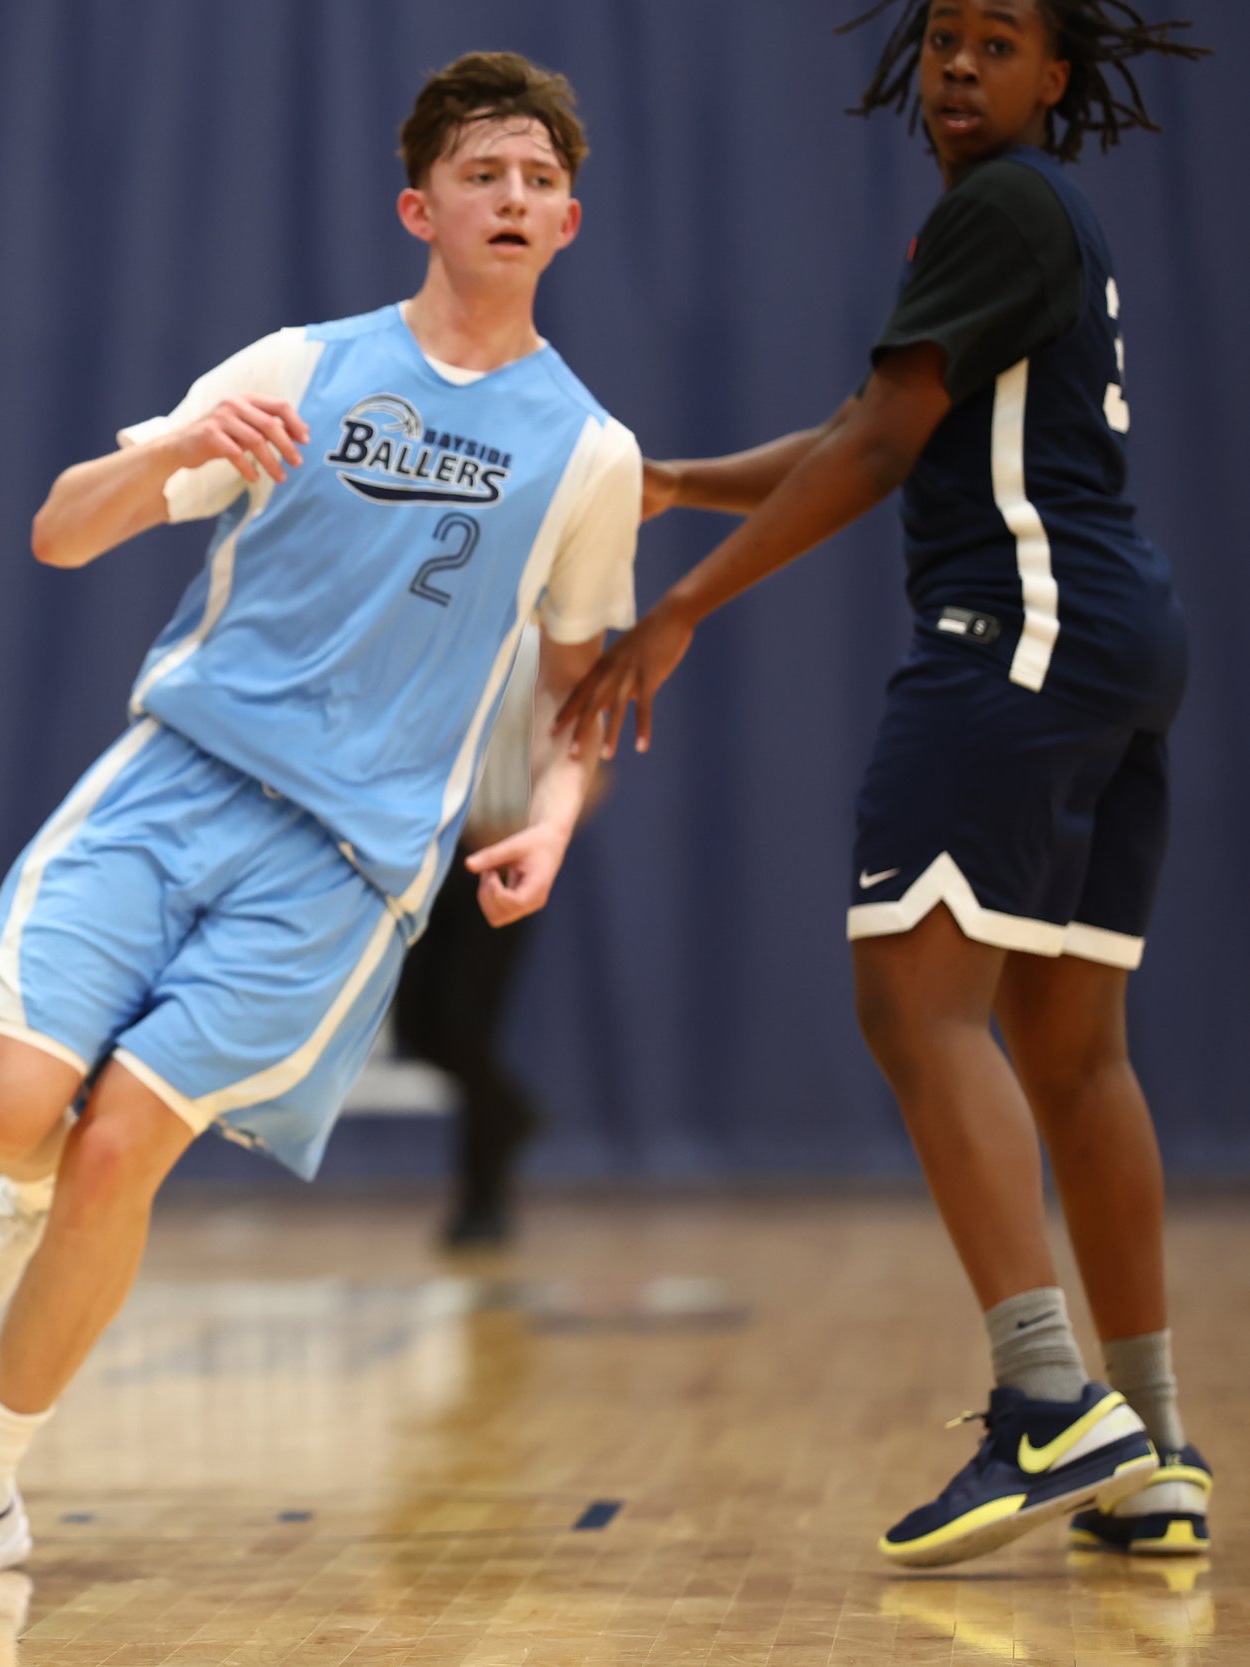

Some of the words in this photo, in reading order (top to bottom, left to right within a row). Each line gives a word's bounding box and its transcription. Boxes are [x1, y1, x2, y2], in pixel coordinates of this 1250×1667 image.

[326, 414, 508, 507] BALLERS
[423, 427, 512, 469] BAYSIDE
[408, 511, 481, 608] 2
